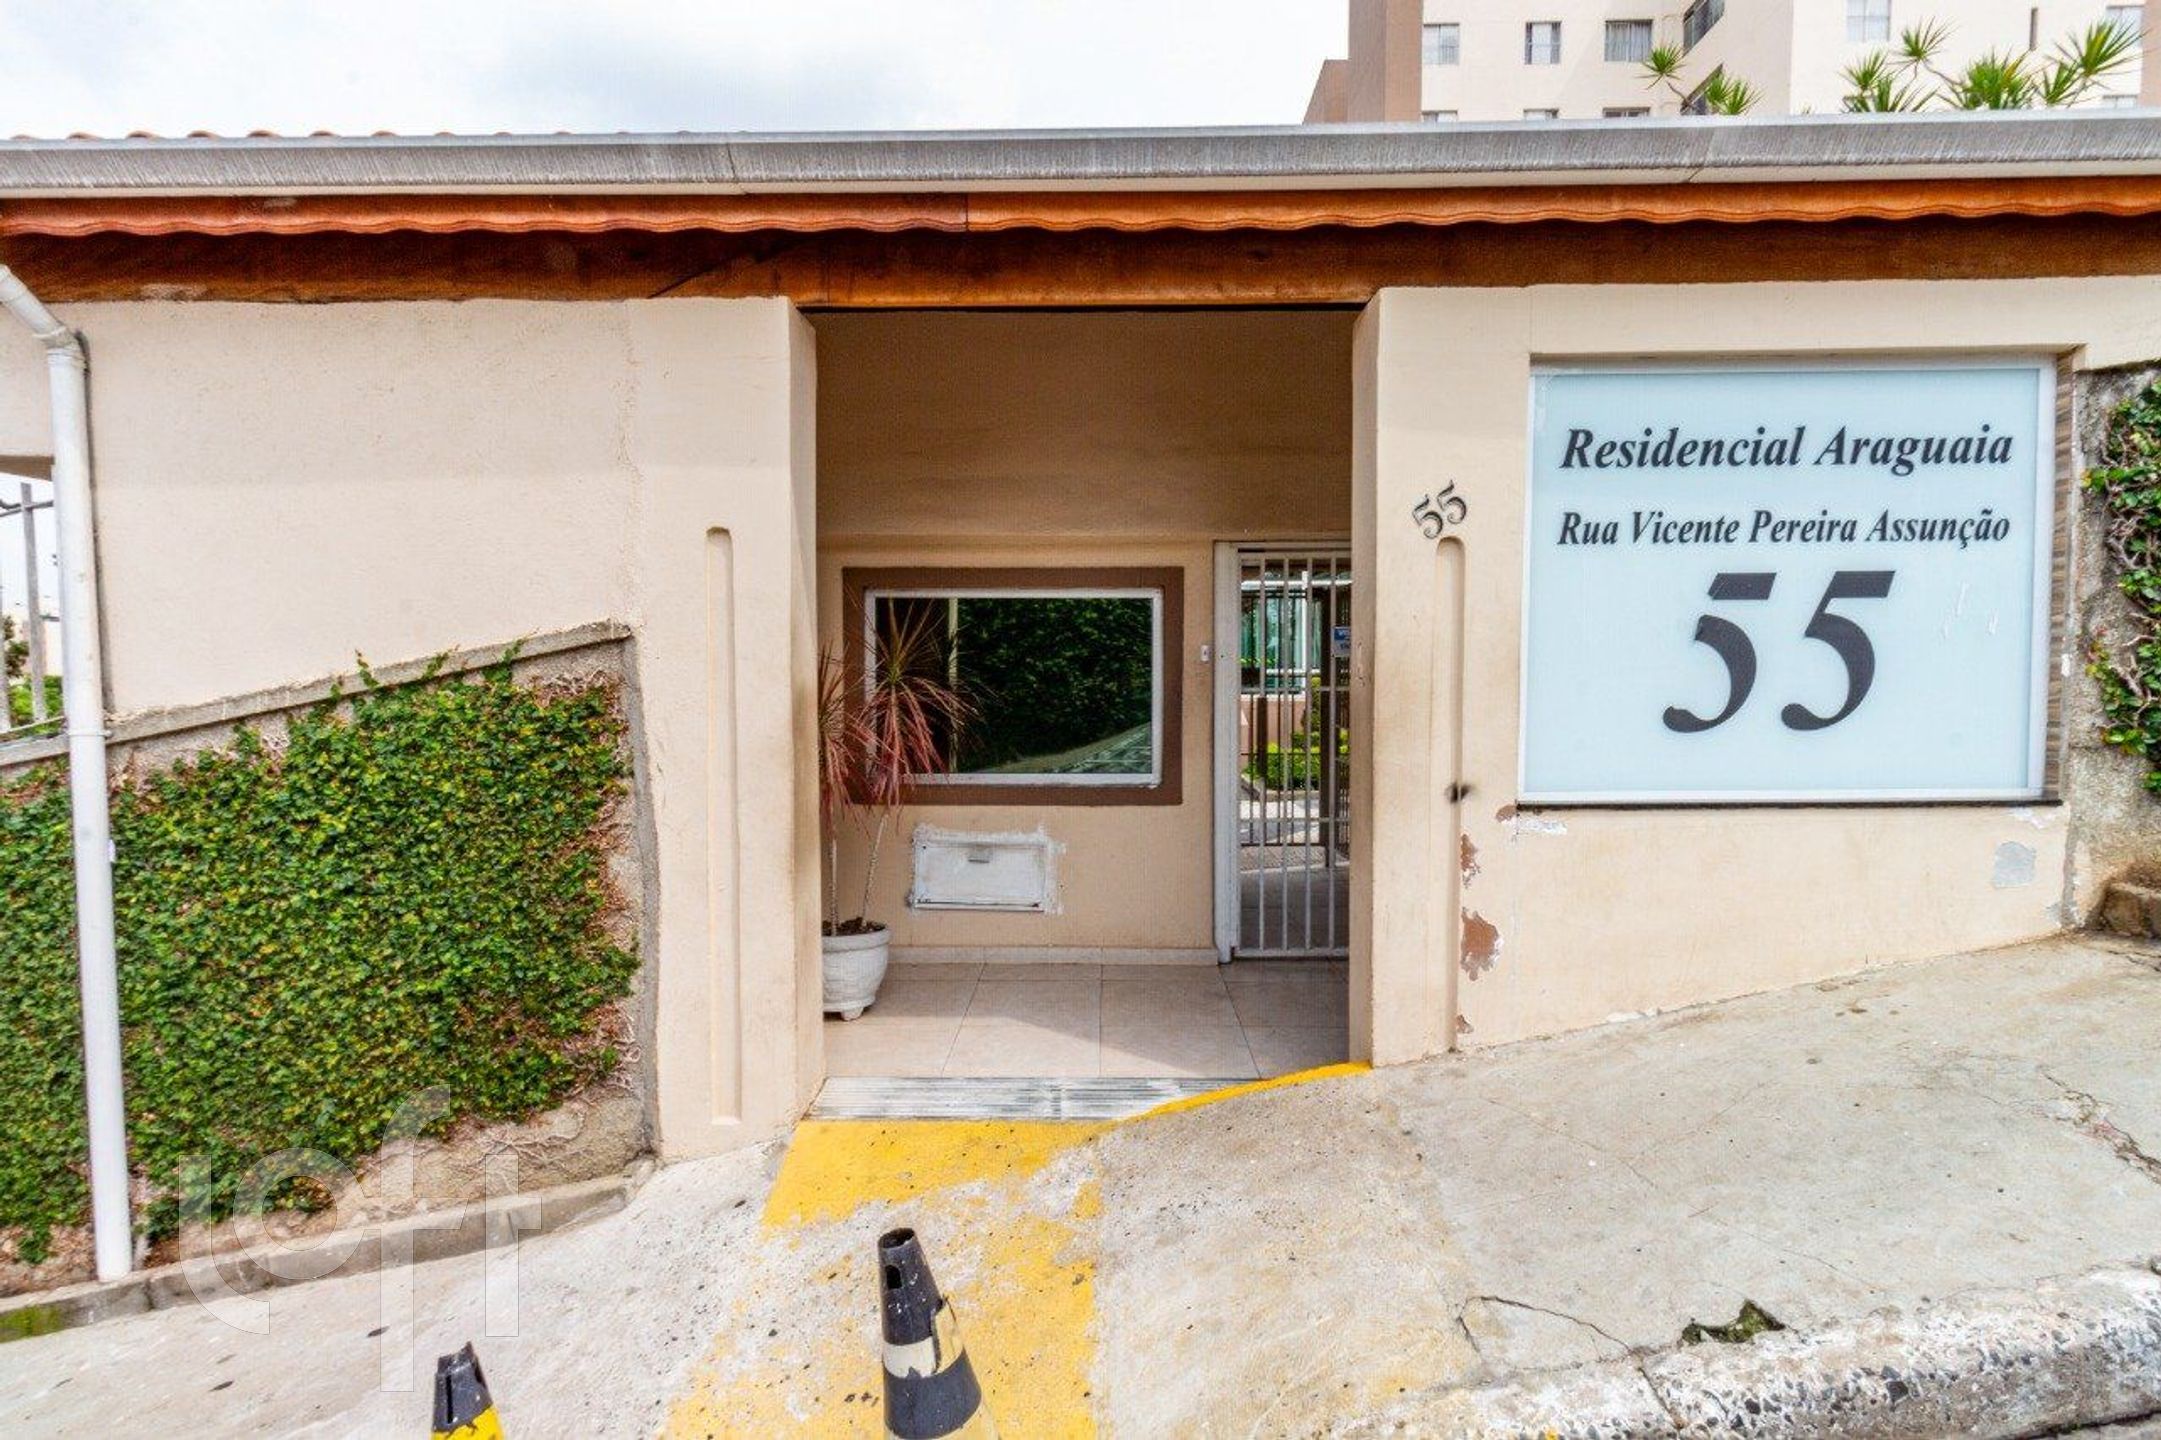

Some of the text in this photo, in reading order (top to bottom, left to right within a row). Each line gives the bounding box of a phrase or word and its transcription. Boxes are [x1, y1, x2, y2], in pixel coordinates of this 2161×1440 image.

[1558, 423, 2013, 477] Residencial Araguaia
[1411, 479, 1467, 540] 55
[1556, 508, 2010, 550] Rua Vicente Pereira Assunção
[1662, 570, 1896, 734] 55
